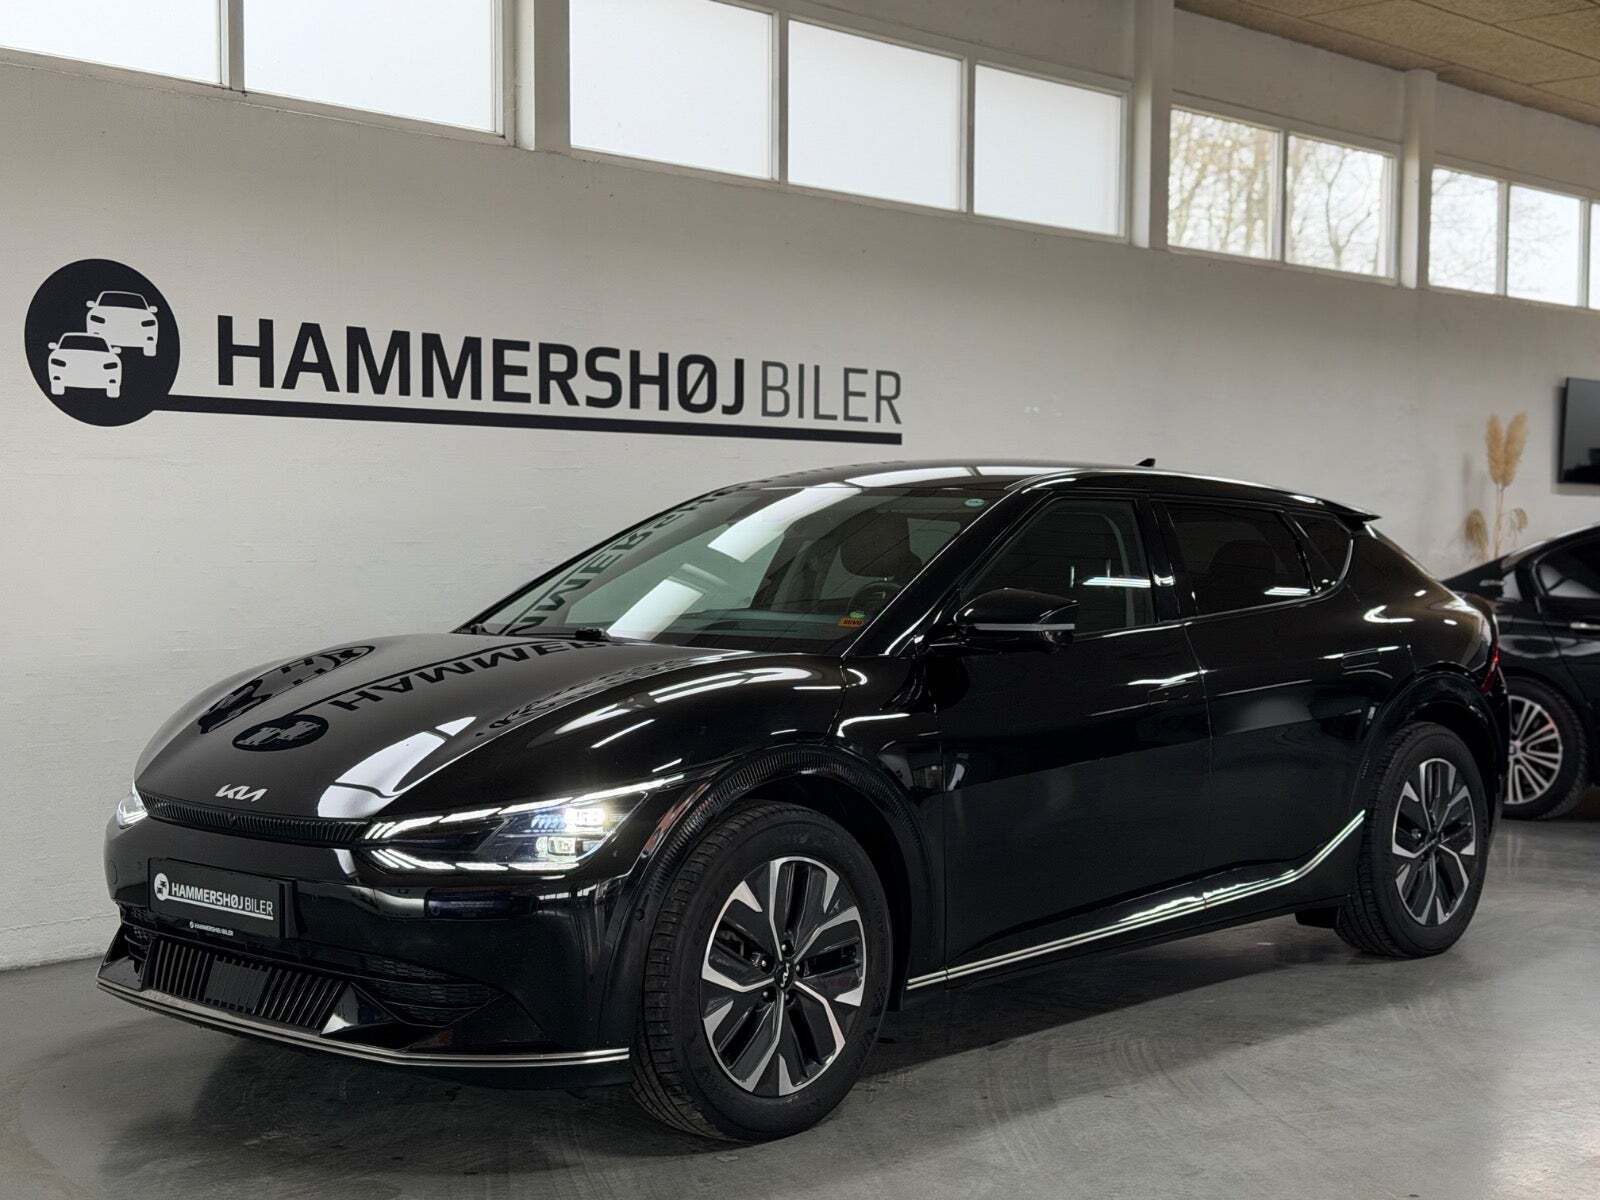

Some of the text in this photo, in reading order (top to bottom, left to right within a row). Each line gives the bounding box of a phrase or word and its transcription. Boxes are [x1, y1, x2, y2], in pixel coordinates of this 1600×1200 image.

[217, 314, 902, 425] HAMMERSHØJ BILER
[171, 882, 273, 915] HAMMERSHØJ BILER
